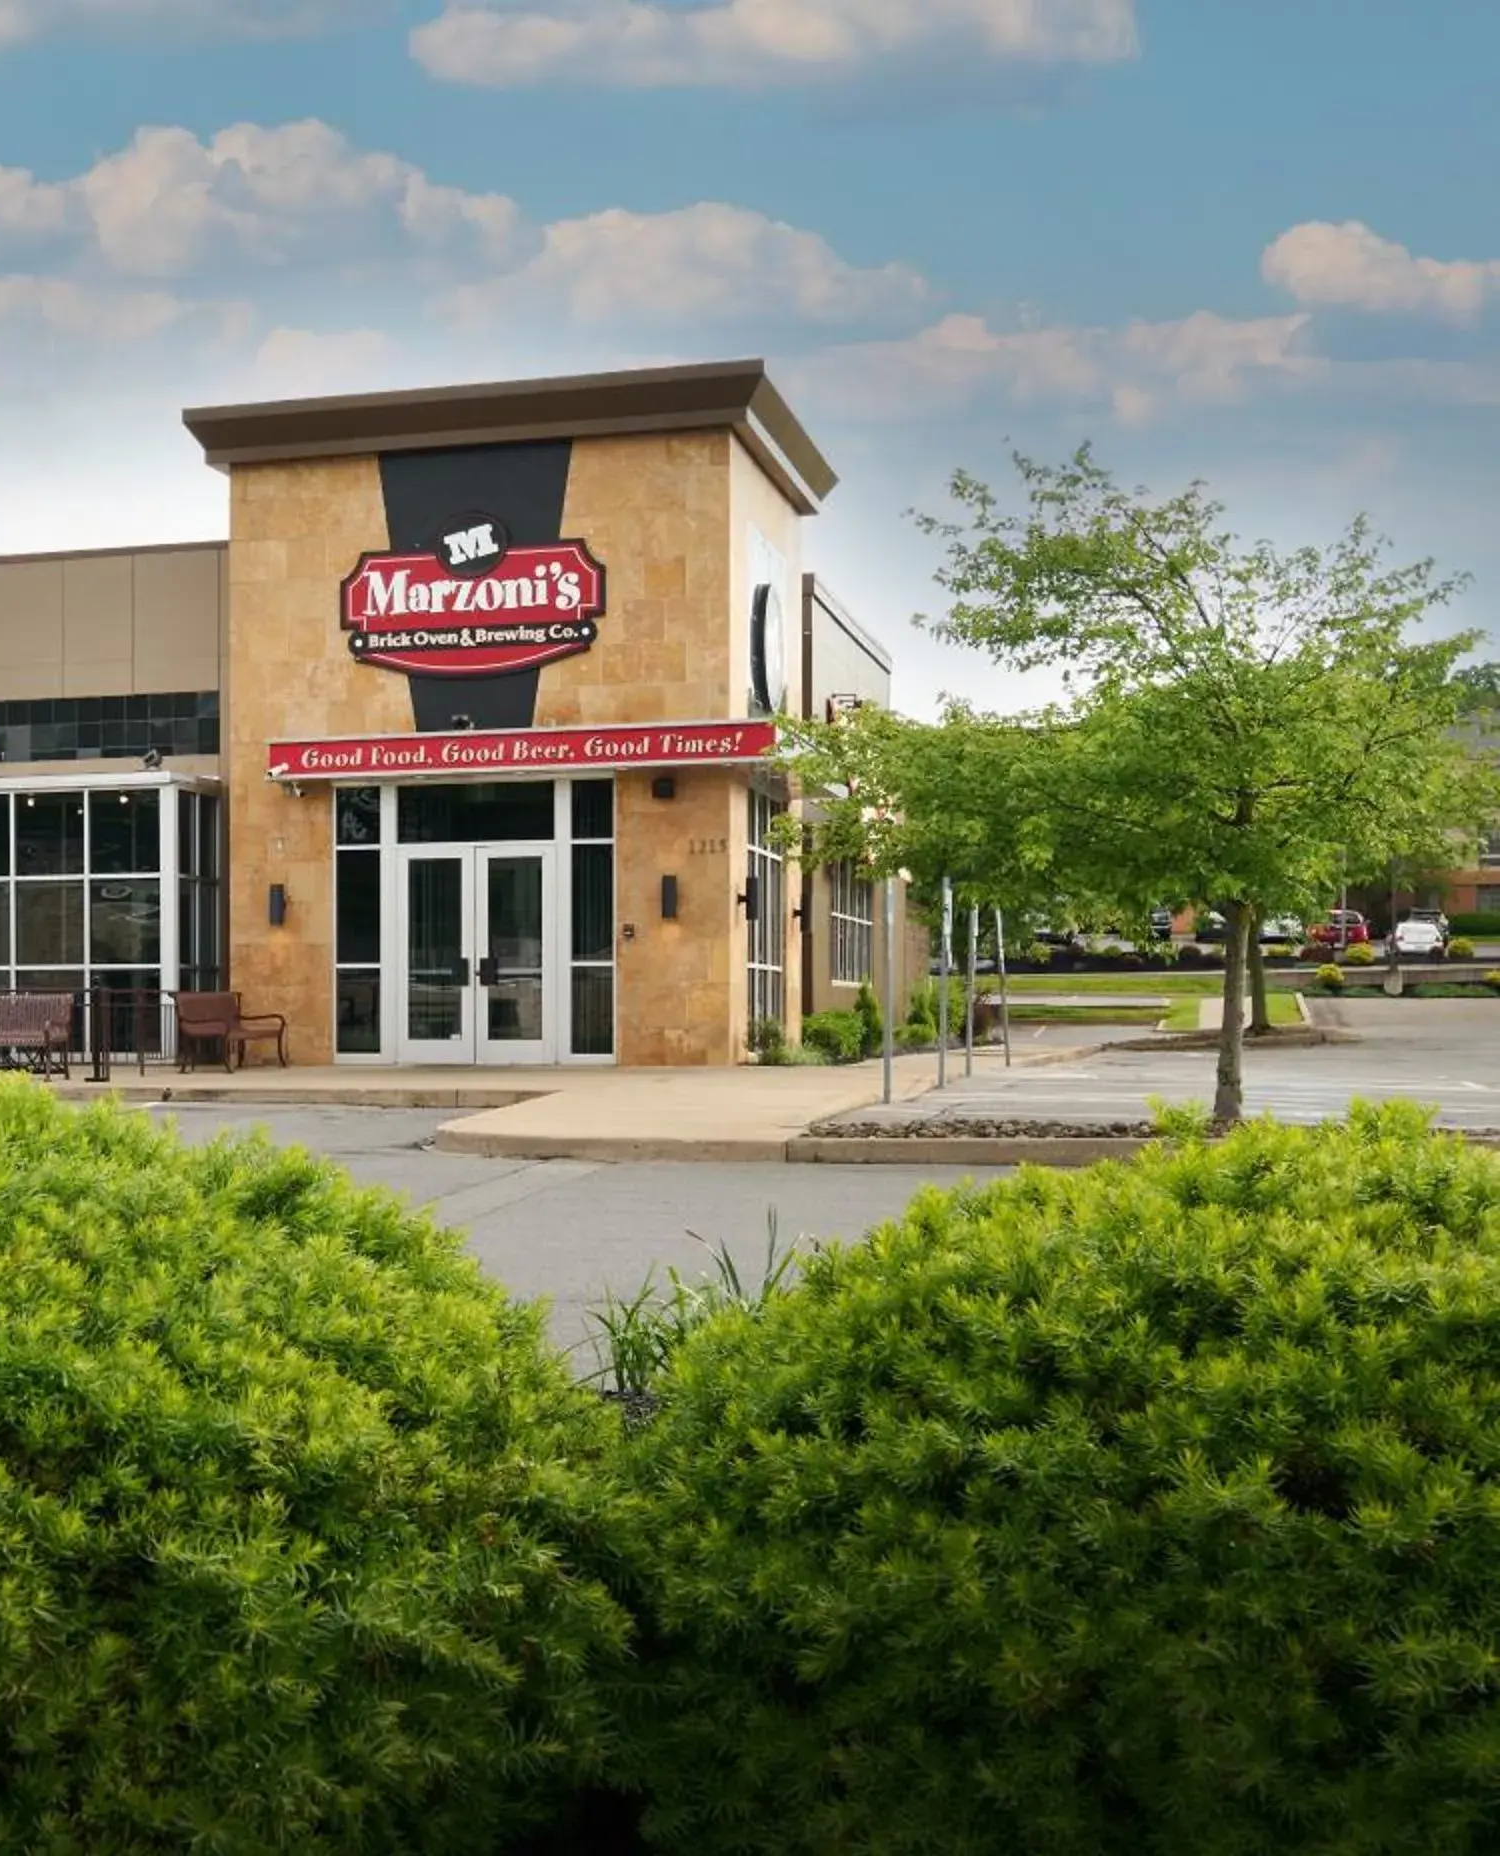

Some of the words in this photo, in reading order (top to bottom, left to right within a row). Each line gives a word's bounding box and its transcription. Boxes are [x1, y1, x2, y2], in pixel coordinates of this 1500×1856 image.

[443, 523, 499, 565] M
[363, 561, 581, 616] Marzoni's
[368, 632, 412, 649] Brick
[413, 629, 458, 646] Oven
[459, 627, 477, 648] &
[475, 624, 547, 643] Brewing
[549, 623, 579, 638] Co.
[300, 747, 362, 768] Good
[441, 740, 504, 762] Good
[584, 735, 650, 758] Good
[660, 731, 743, 754] Times!
